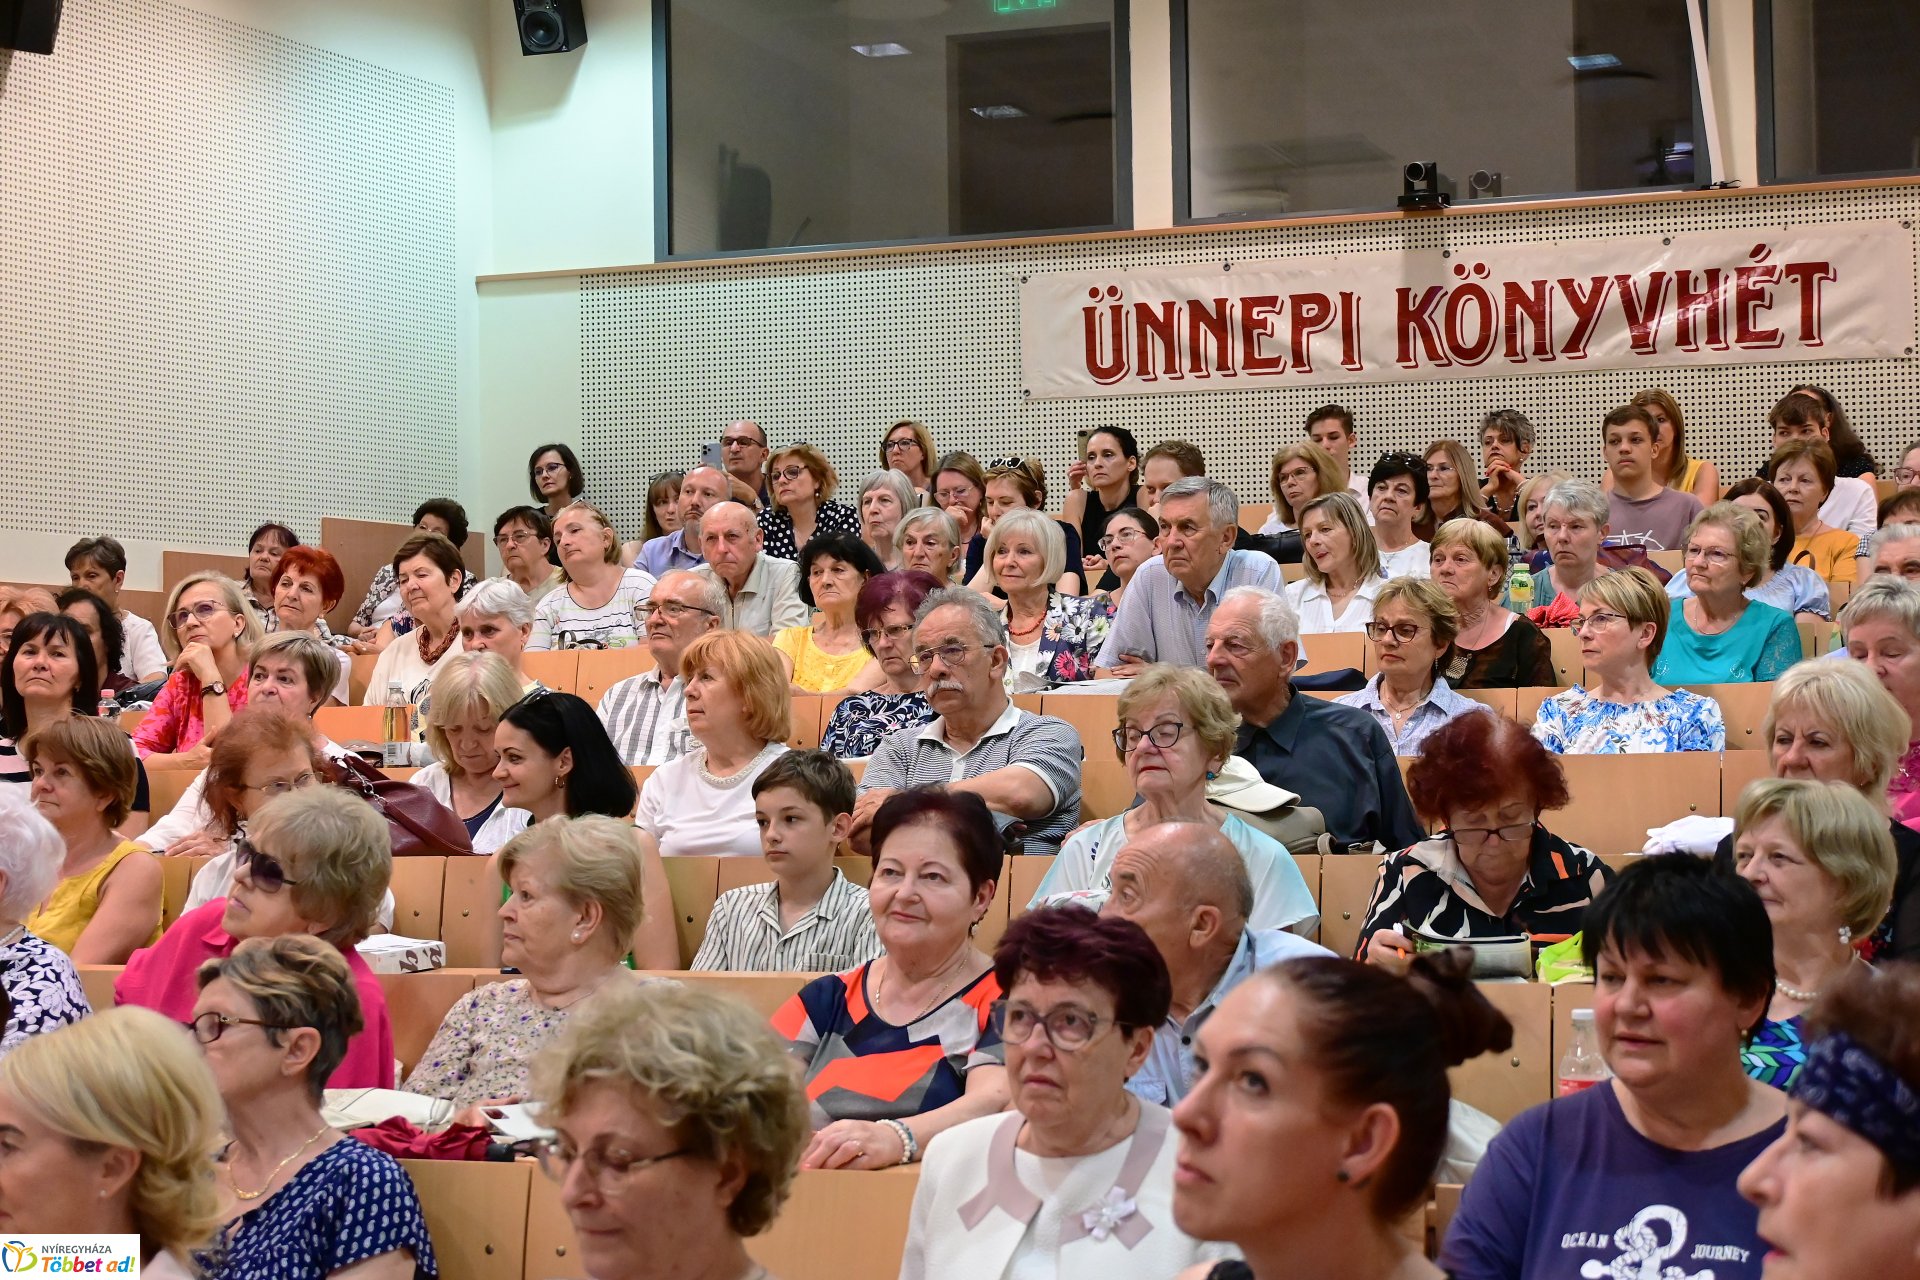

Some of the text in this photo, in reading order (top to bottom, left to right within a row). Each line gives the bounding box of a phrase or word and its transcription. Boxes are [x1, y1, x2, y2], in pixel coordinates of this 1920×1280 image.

[1083, 243, 1837, 386] ÜNNEPI KÖNYVHÉT
[1561, 1231, 1750, 1263] OCEAN JOURNEY
